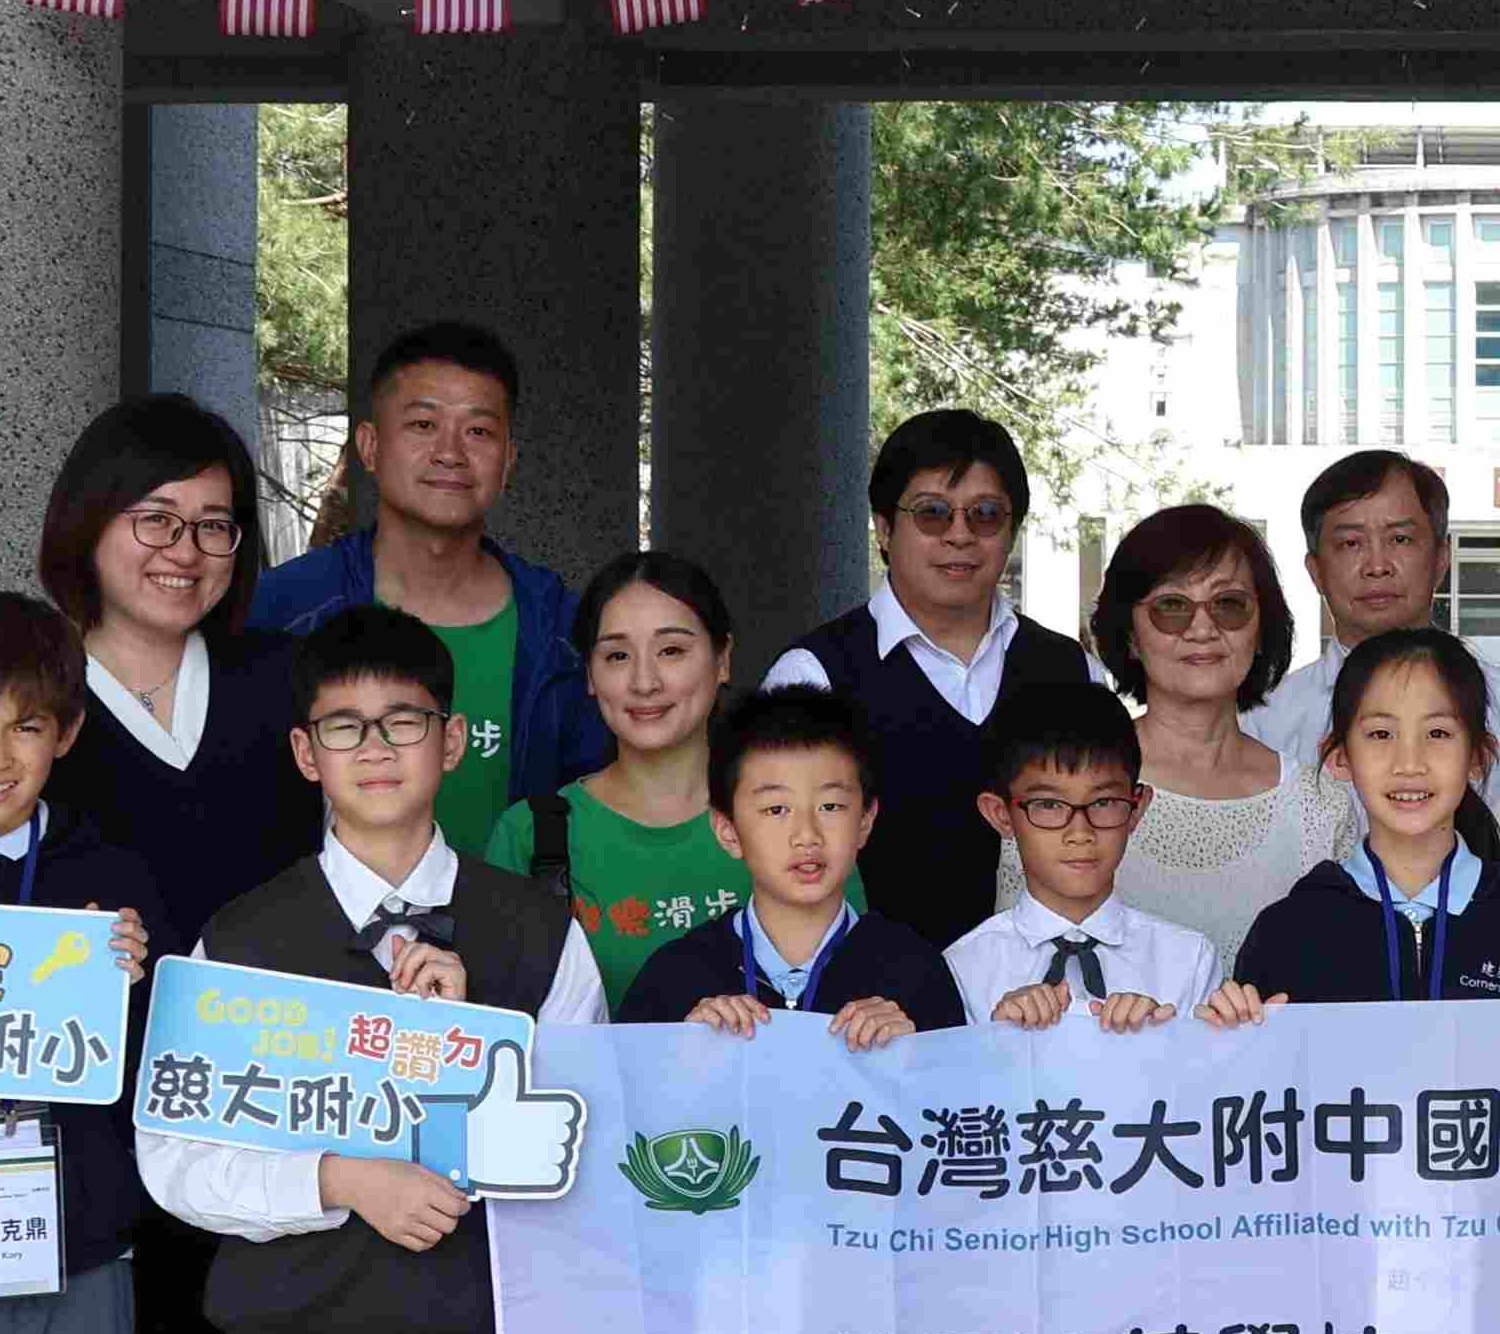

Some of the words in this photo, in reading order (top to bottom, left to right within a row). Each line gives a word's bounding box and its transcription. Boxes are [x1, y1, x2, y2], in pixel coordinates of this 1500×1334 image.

[145, 1052, 424, 1143] 慈大附小
[826, 1222, 879, 1251] Tzu
[889, 1227, 935, 1253] Chi
[944, 1226, 1040, 1253] Senior
[1045, 1223, 1111, 1253] High
[1121, 1215, 1222, 1245] School
[1231, 1212, 1361, 1239] Affiliated
[1370, 1213, 1432, 1239] with
[1442, 1214, 1487, 1238] Tzu
